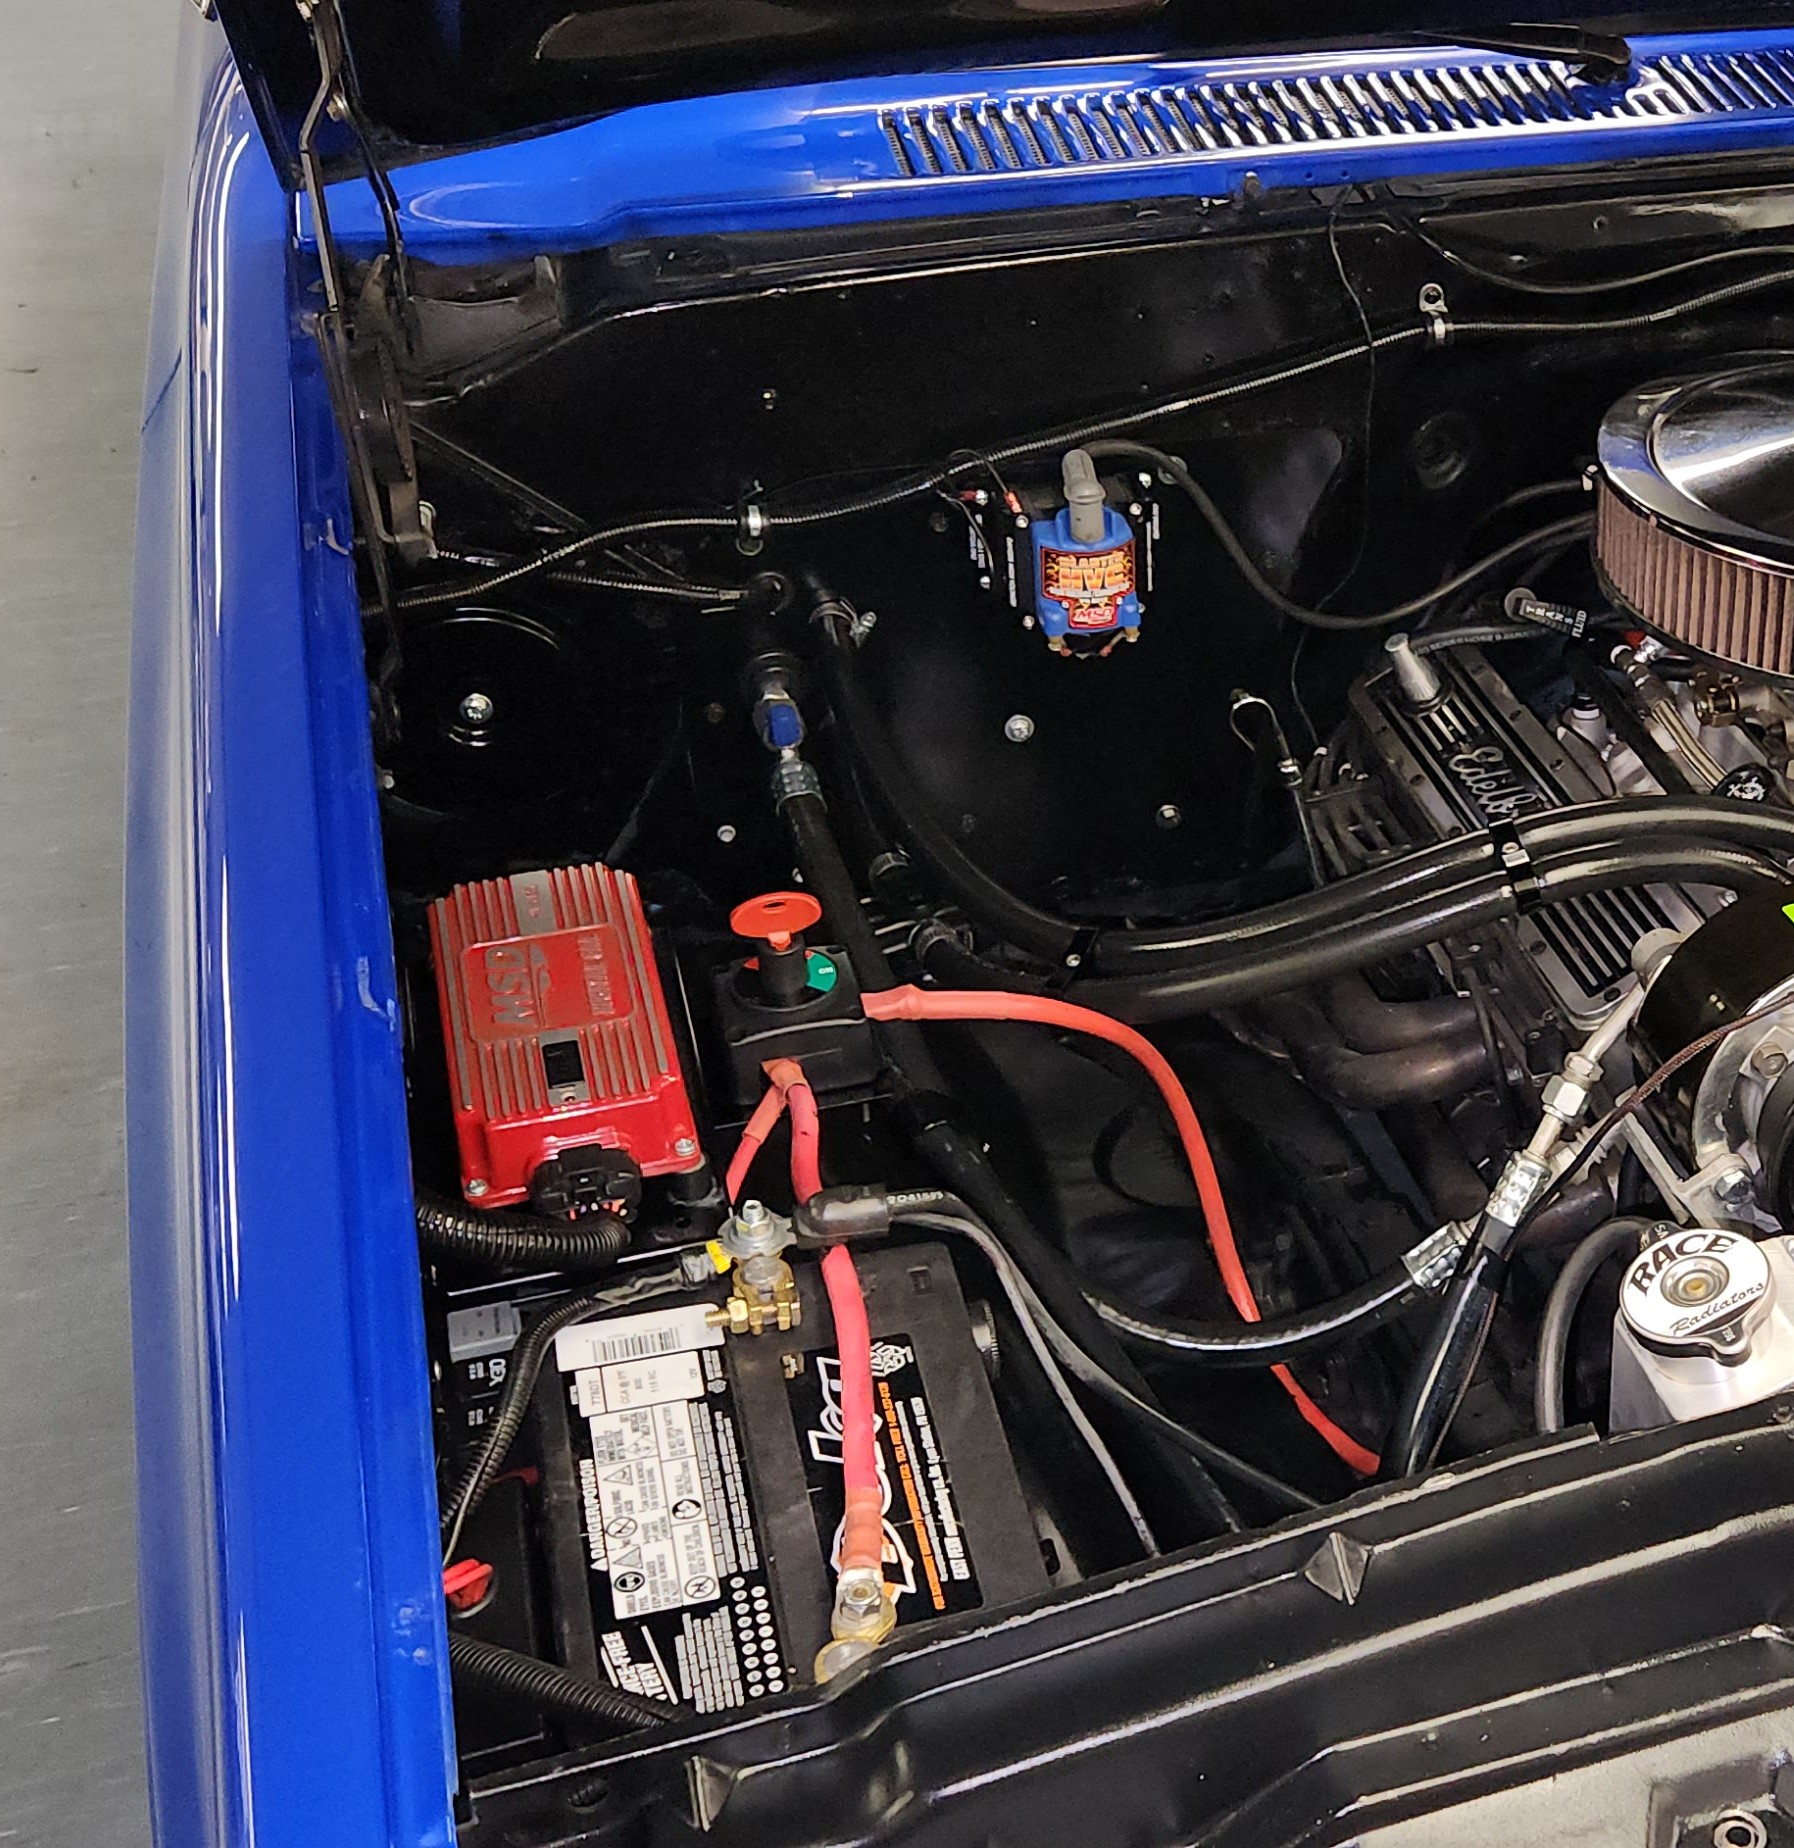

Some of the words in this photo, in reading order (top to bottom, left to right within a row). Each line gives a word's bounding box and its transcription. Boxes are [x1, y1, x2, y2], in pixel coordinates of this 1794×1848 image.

[1059, 563, 1125, 591] HVC
[1449, 746, 1538, 816] Edelb
[485, 945, 537, 1025] MSD
[1628, 1233, 1739, 1297] RACE
[1669, 1282, 1764, 1335] Radiators
[579, 1459, 606, 1559] DANGER/POISON
